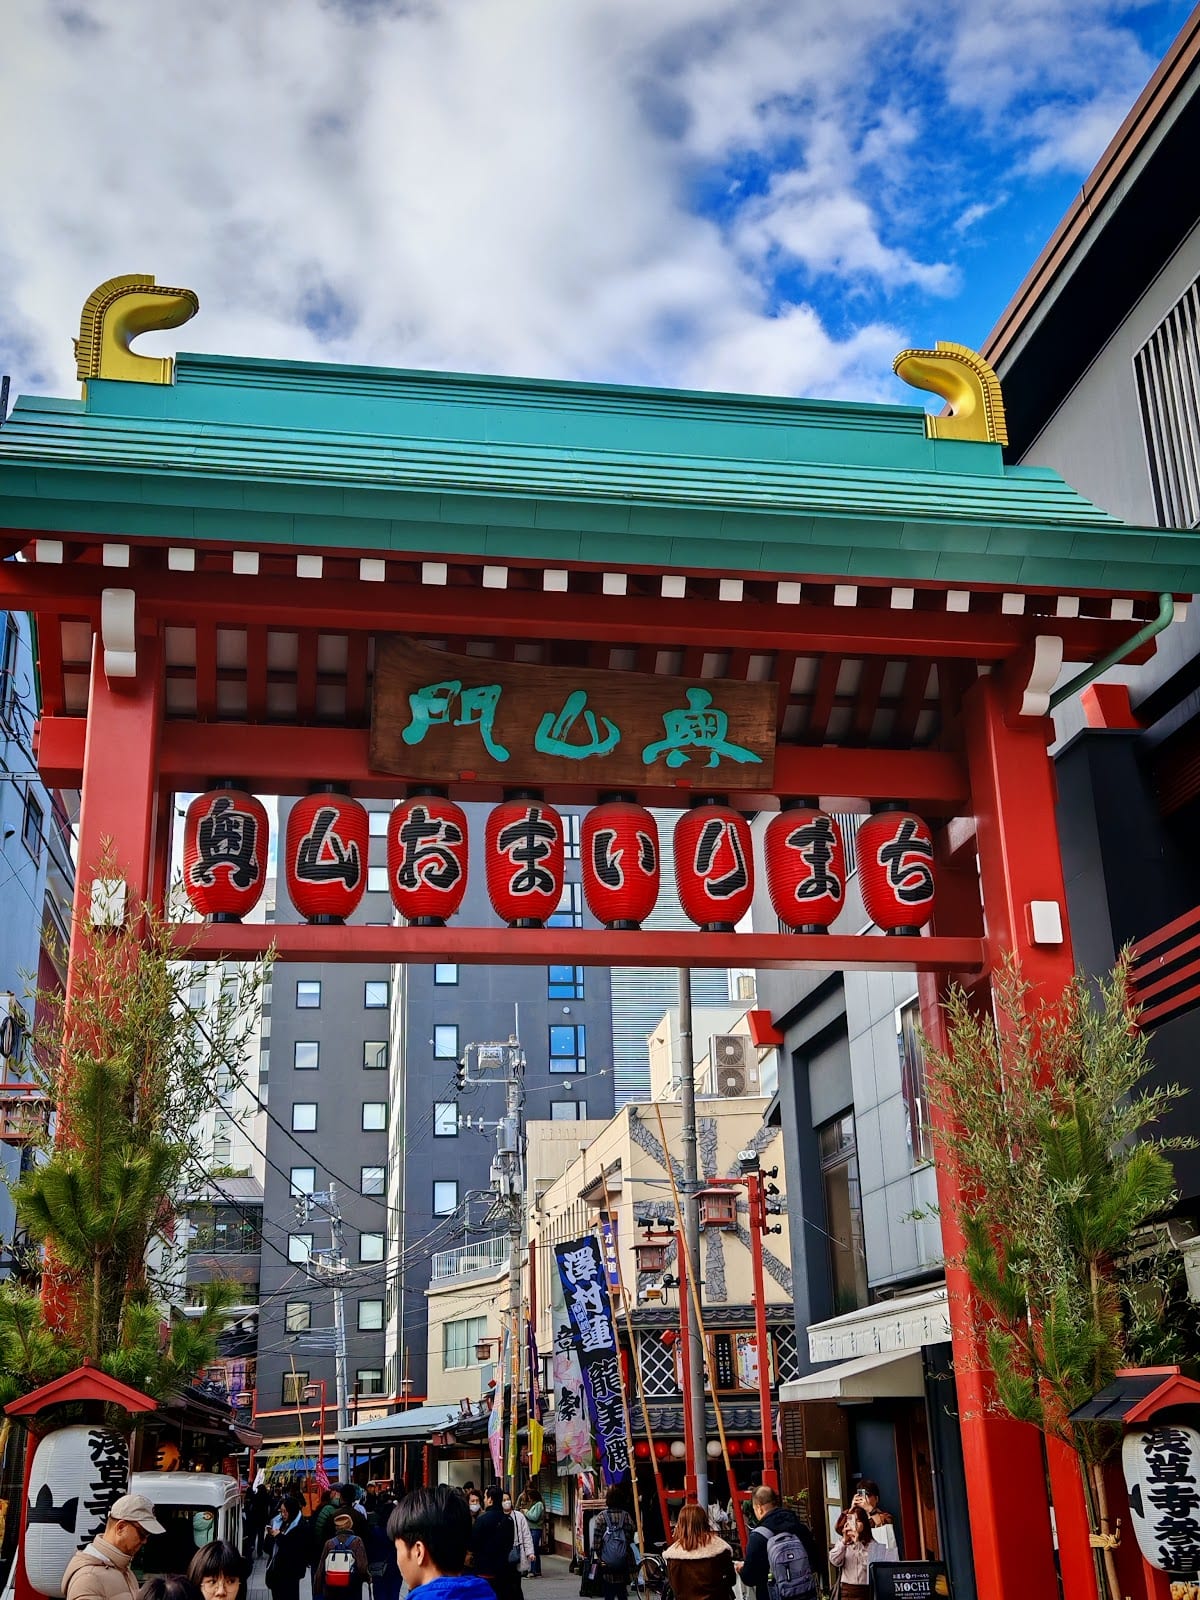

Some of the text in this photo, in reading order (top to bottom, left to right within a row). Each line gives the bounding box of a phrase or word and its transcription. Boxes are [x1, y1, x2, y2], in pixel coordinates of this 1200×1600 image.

[77, 1428, 129, 1550] 浅草寺
[894, 1581, 930, 1592] MOCHI
